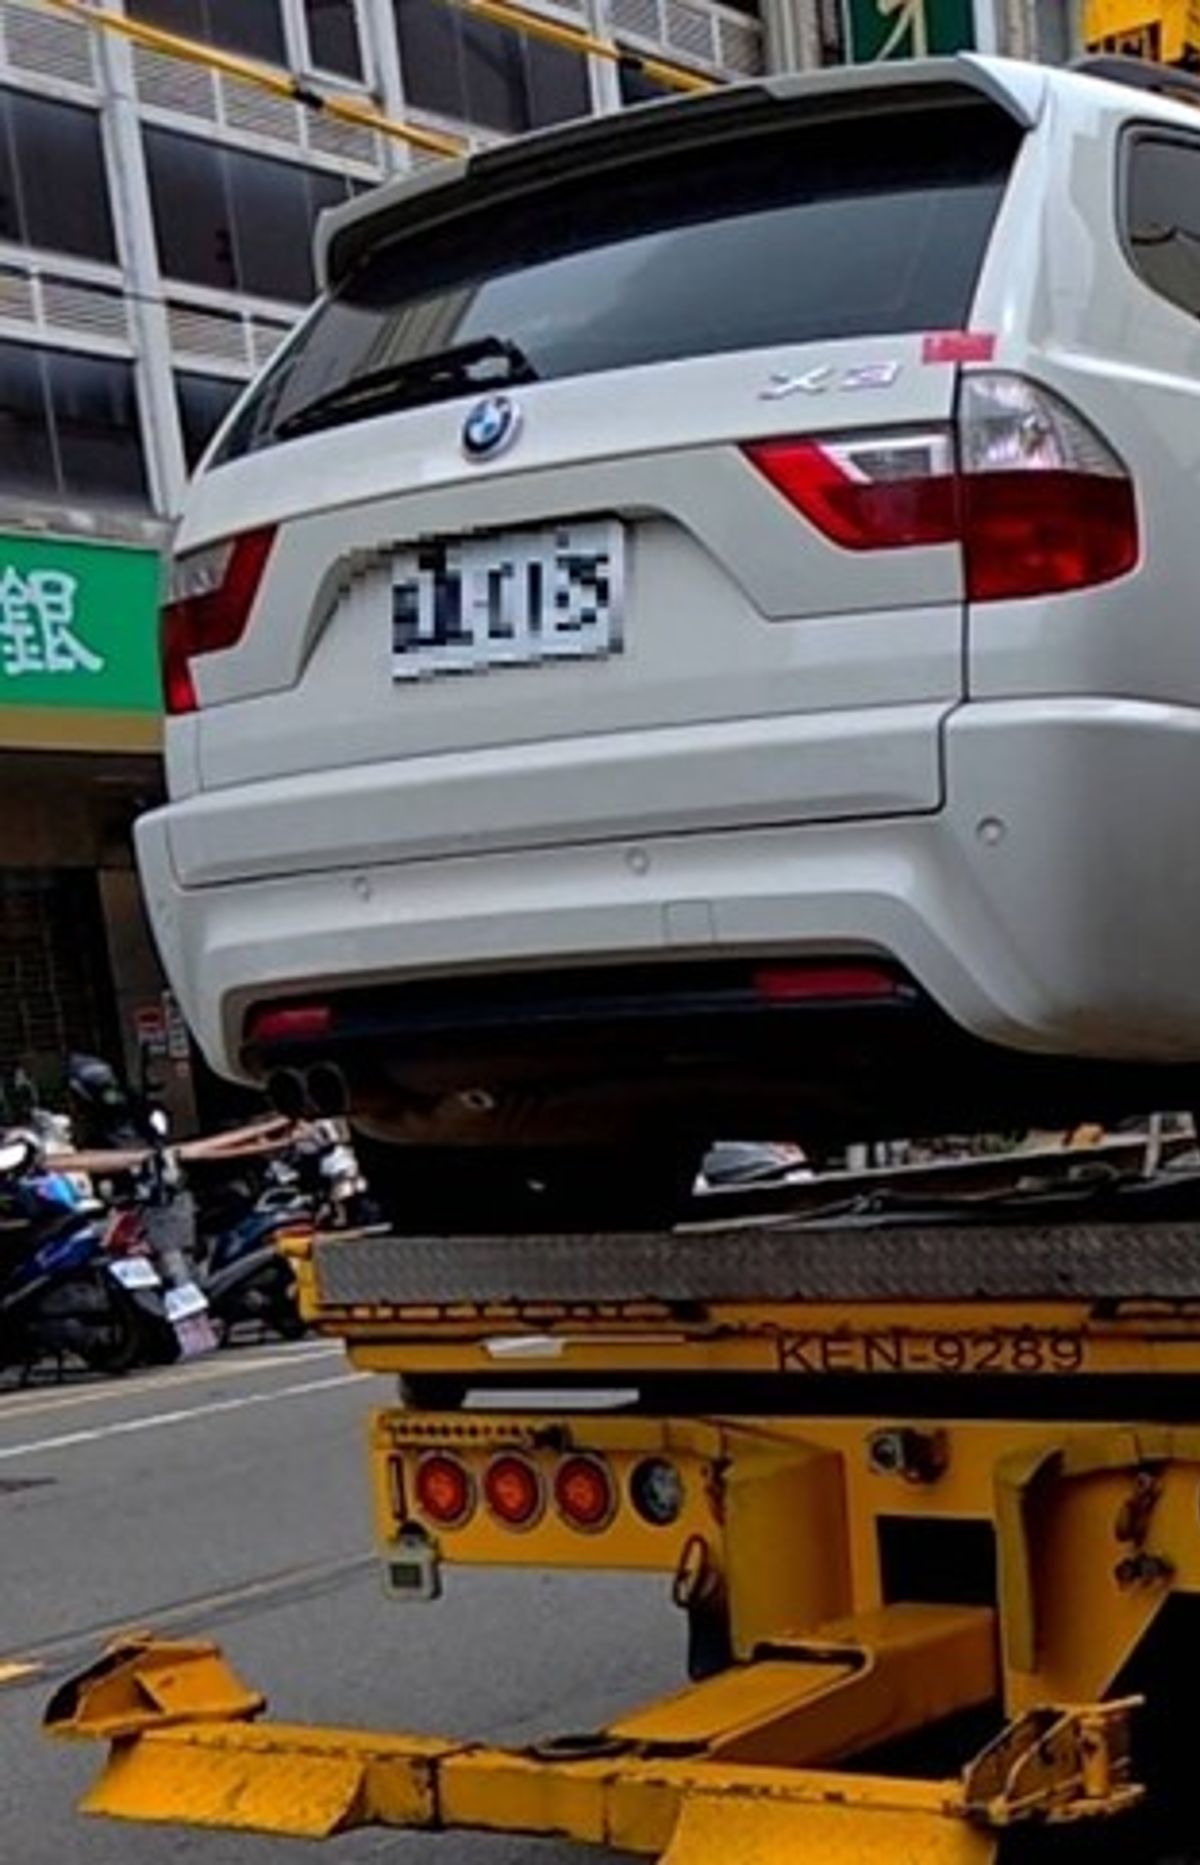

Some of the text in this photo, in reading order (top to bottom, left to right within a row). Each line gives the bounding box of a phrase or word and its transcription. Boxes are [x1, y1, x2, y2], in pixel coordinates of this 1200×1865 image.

[759, 361, 901, 400] X3
[0, 565, 105, 674] 銀
[775, 1331, 1084, 1373] KEN-9289
